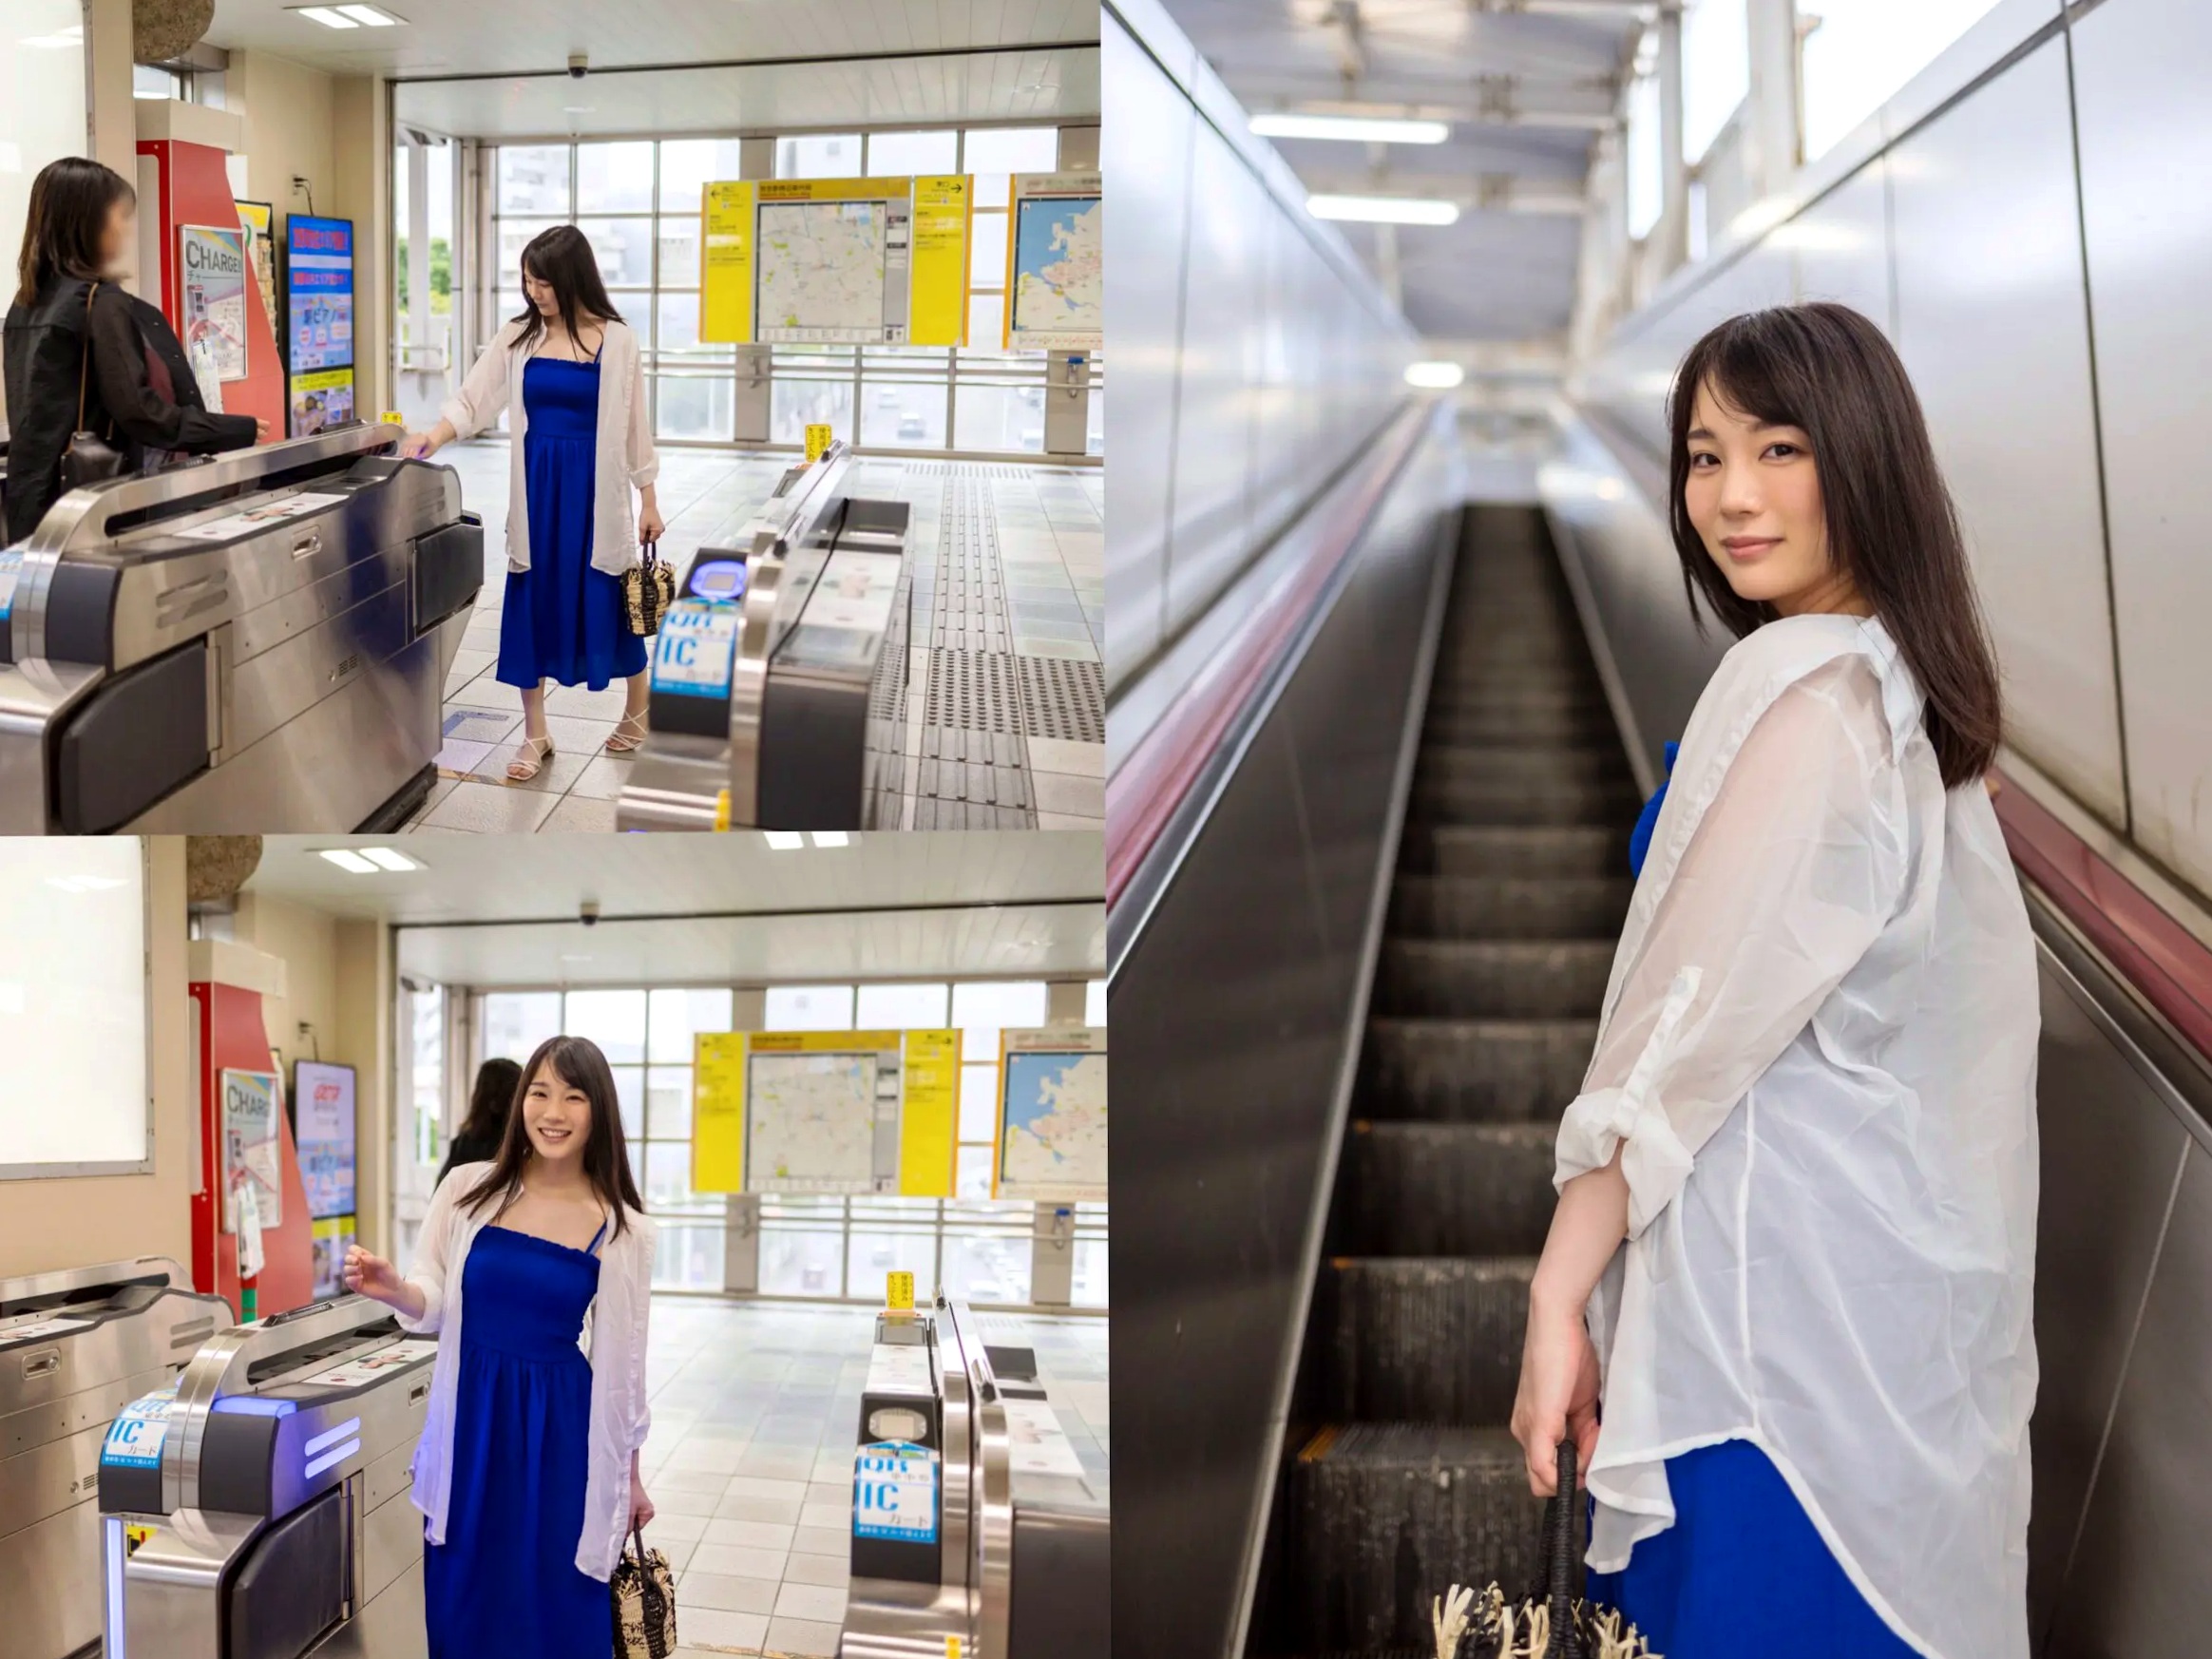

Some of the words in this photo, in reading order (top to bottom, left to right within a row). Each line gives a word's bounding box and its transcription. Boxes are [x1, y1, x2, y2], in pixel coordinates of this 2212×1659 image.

[663, 637, 697, 666] IC
[113, 1420, 144, 1443] IC
[864, 1482, 899, 1511] IC
